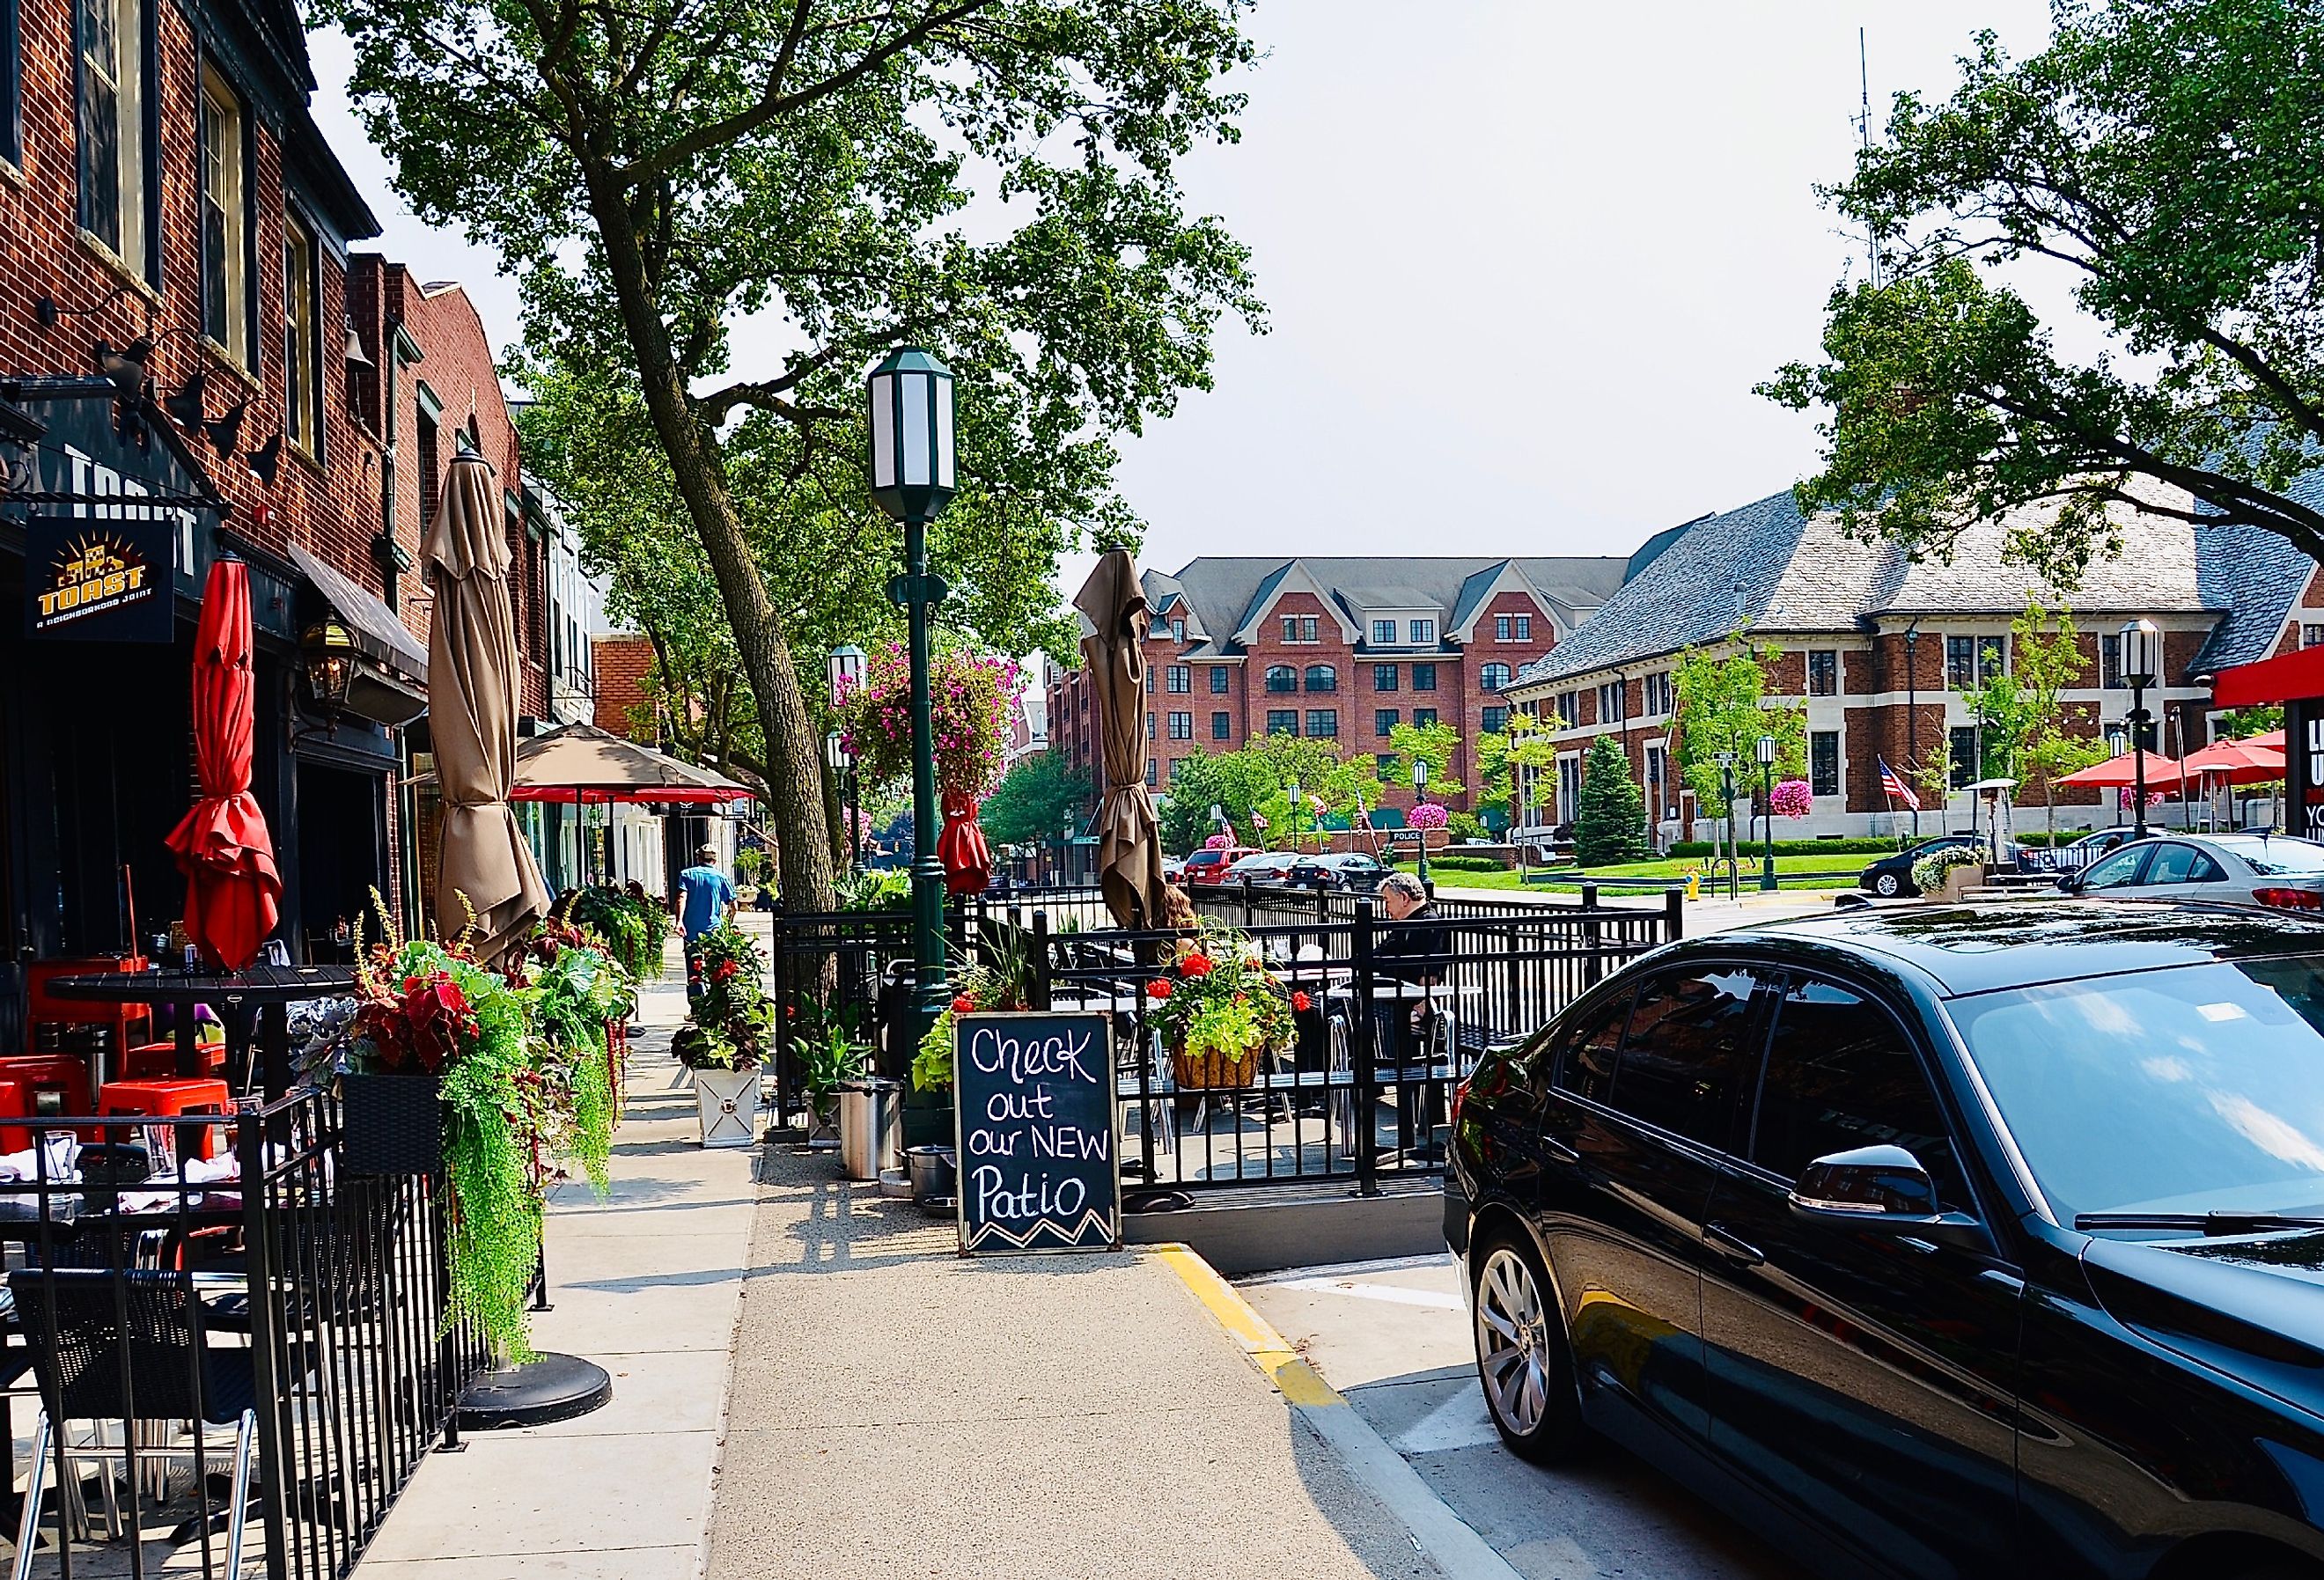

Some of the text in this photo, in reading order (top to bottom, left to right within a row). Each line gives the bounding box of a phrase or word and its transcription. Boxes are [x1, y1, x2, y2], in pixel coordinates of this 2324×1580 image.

[64, 443, 197, 577] TOT
[38, 565, 145, 615] TOAST
[47, 599, 119, 626] NEIGHBORHOOD
[122, 588, 151, 603] JOINT
[971, 1028, 1097, 1084] Check
[987, 1084, 1054, 1121] out
[968, 1124, 1108, 1161] our NEW
[971, 1165, 1085, 1224] Patio
